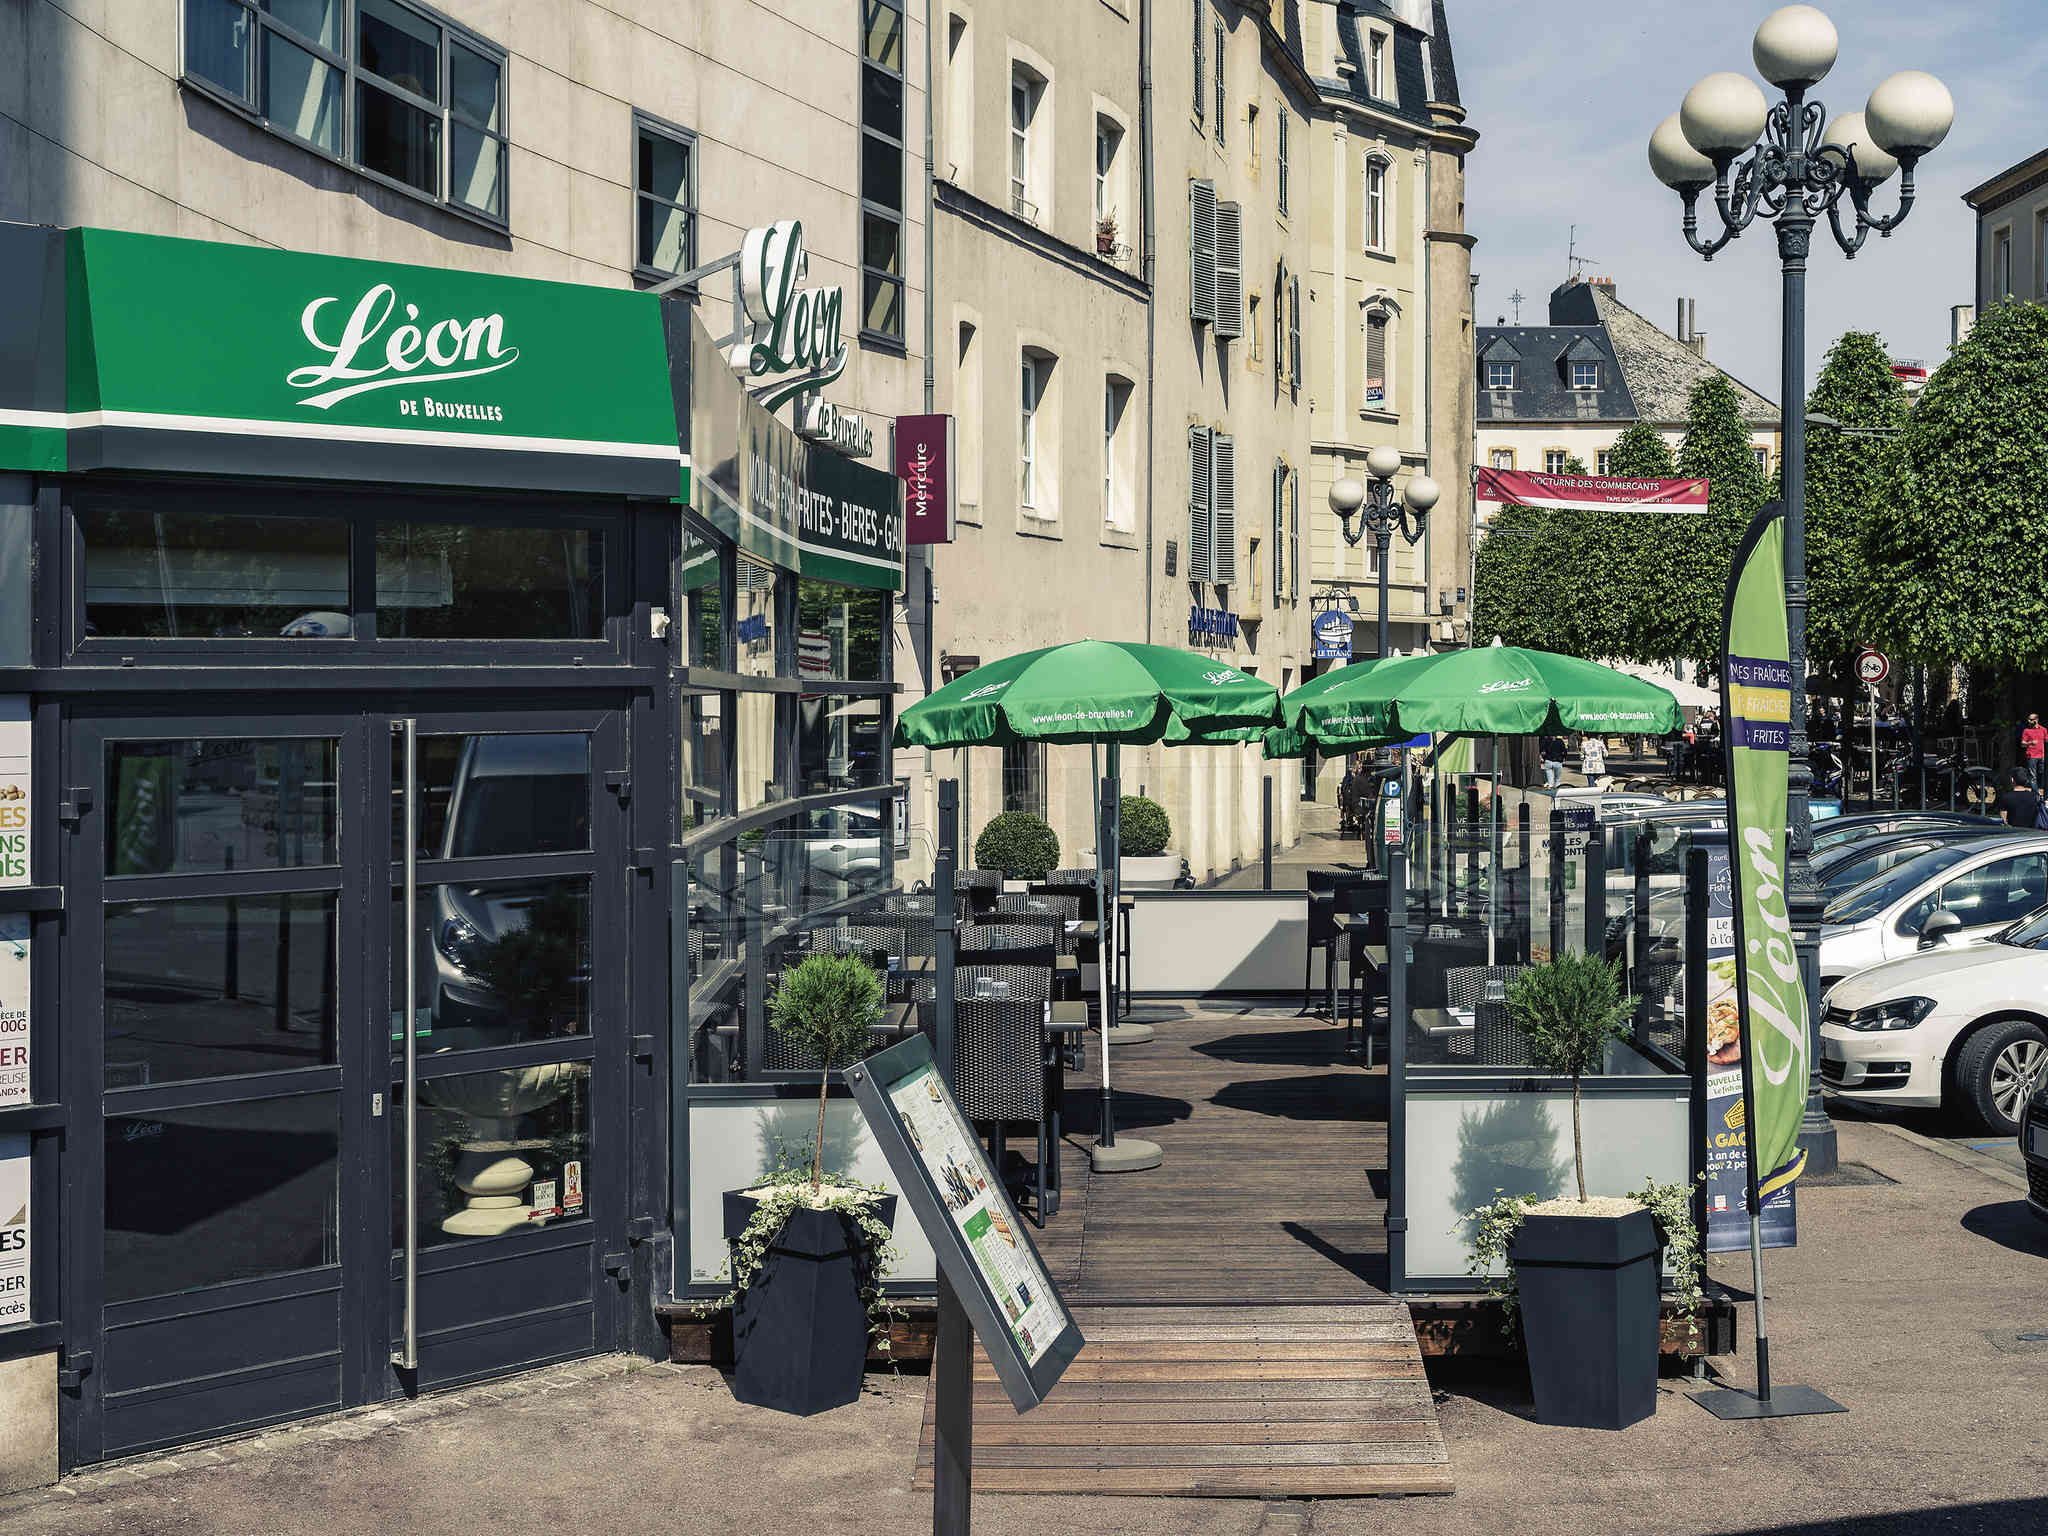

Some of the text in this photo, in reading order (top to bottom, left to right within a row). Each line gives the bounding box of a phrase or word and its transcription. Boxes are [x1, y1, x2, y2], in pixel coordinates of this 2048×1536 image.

[831, 404, 873, 457] Bruxelles
[915, 443, 928, 516] Mercure
[1530, 476, 1575, 488] NOCTURNE
[1577, 481, 1593, 489] DES
[799, 487, 833, 536] FRITES
[841, 501, 878, 547] BIERES
[1318, 649, 1351, 657] LE TITANIC
[1753, 729, 1785, 745] FRITES
[1709, 883, 1726, 892] Fish
[1716, 919, 1728, 930] Le
[1710, 933, 1718, 945] à
[0, 1046, 28, 1067] ER
[1729, 1150, 1741, 1160] de
[1726, 1160, 1733, 1170] 2
